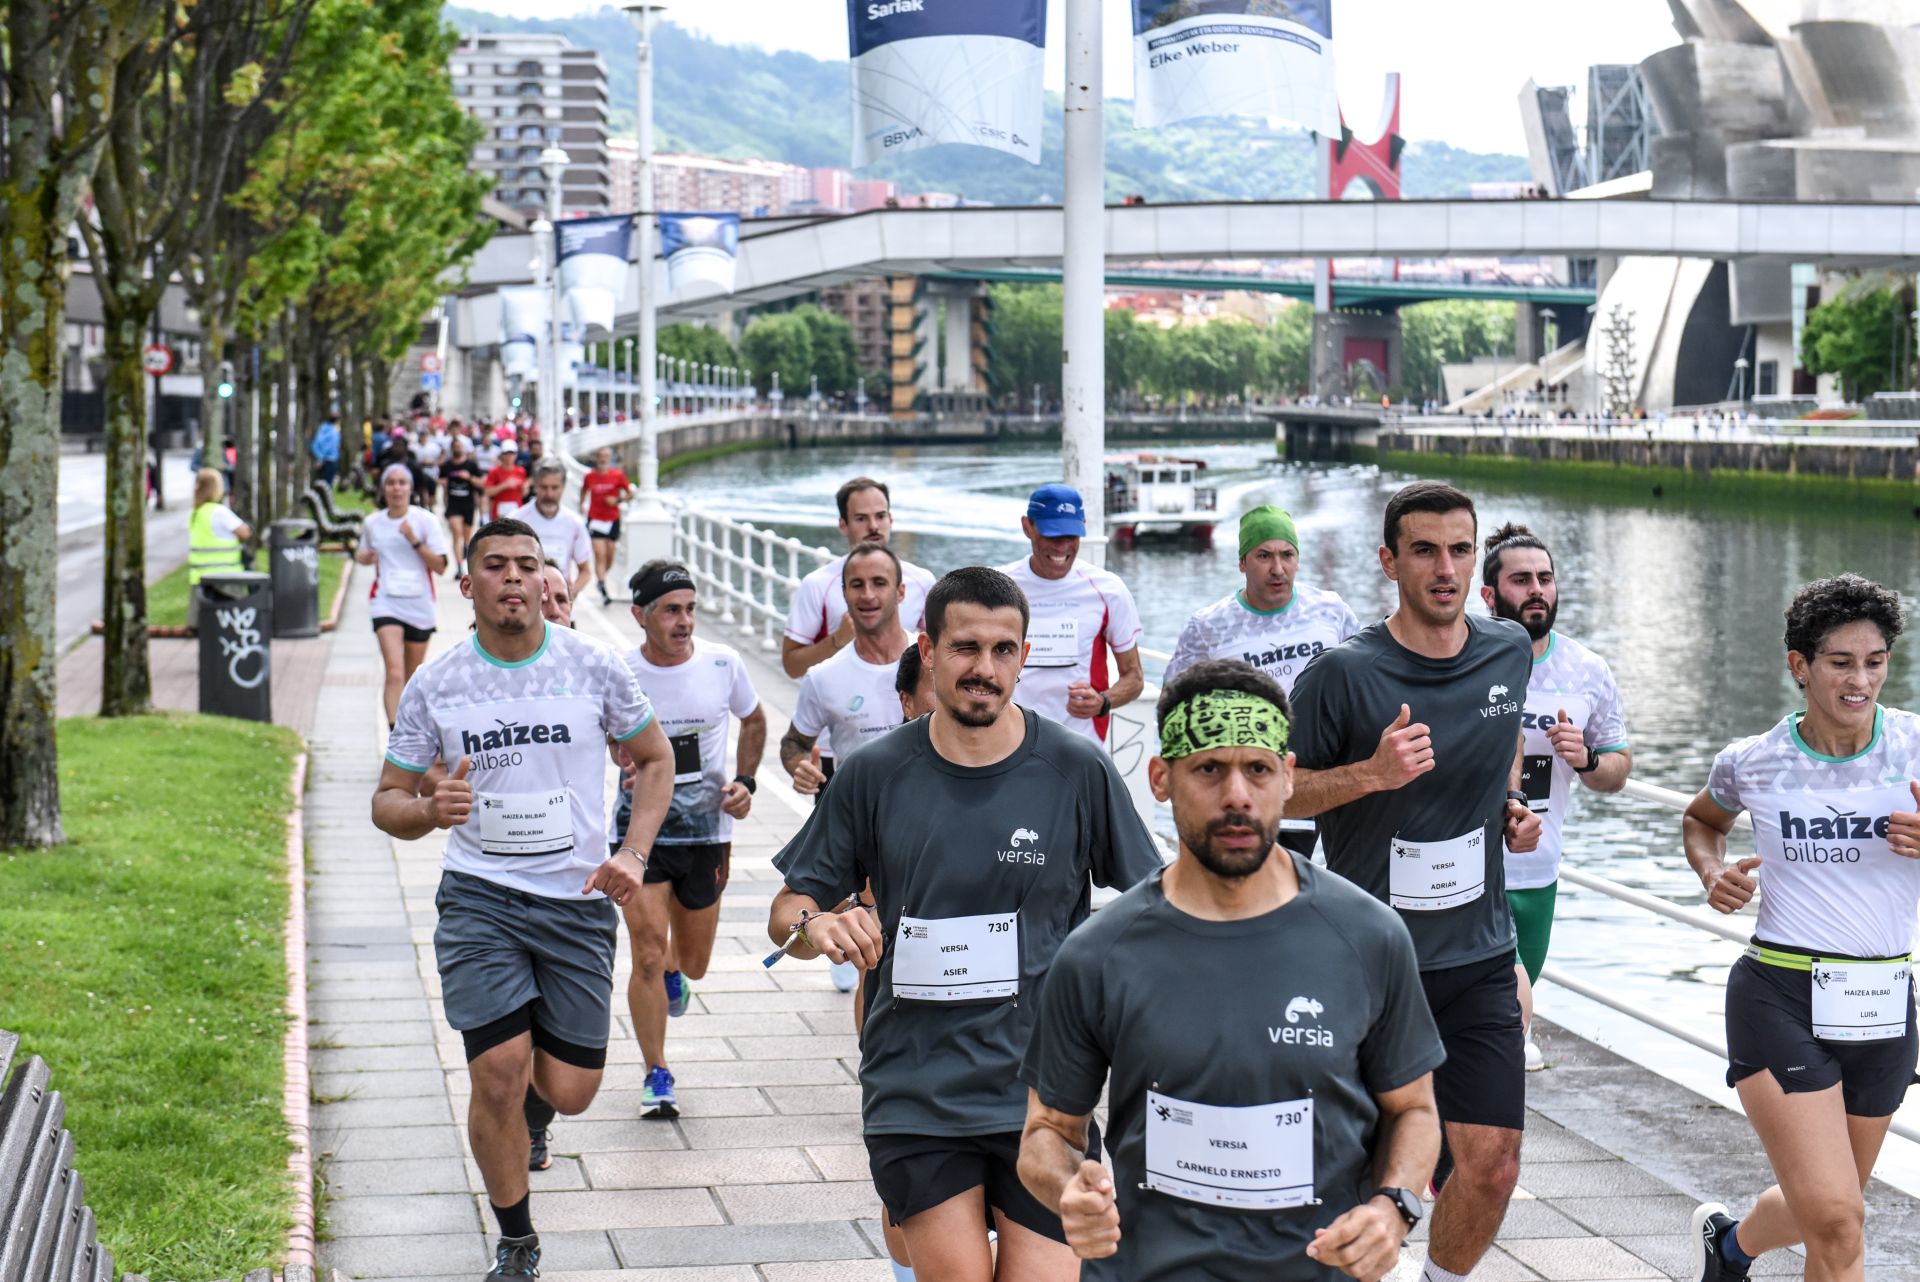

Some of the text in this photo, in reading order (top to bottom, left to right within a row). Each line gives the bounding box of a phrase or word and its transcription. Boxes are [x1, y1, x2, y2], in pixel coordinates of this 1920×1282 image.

[867, 0, 924, 20] Sariak
[1150, 40, 1240, 68] Elke Weber
[883, 126, 923, 148] BBVA
[1243, 640, 1324, 668] haizea
[1480, 699, 1518, 718] versia
[1231, 706, 1257, 745] REYES
[461, 719, 572, 755] haizea
[1536, 759, 1547, 768] 79
[548, 795, 564, 805] 613
[1779, 805, 1892, 840] haize
[1467, 836, 1480, 849] 730
[997, 849, 1046, 866] versia
[1783, 841, 1861, 863] bilbao
[1431, 861, 1455, 871] VERSIA
[1430, 880, 1457, 891] ADRIÁN
[988, 922, 1009, 933] 730
[940, 944, 969, 953] VERSIA
[943, 967, 968, 977] ASIER
[1844, 988, 1891, 997] HAIZEA BILBAO
[1268, 1024, 1334, 1048] versia
[1275, 1111, 1302, 1127] 730
[1209, 1138, 1248, 1150] VERSIA
[1176, 1159, 1282, 1180] CARMELO ERNESTO
